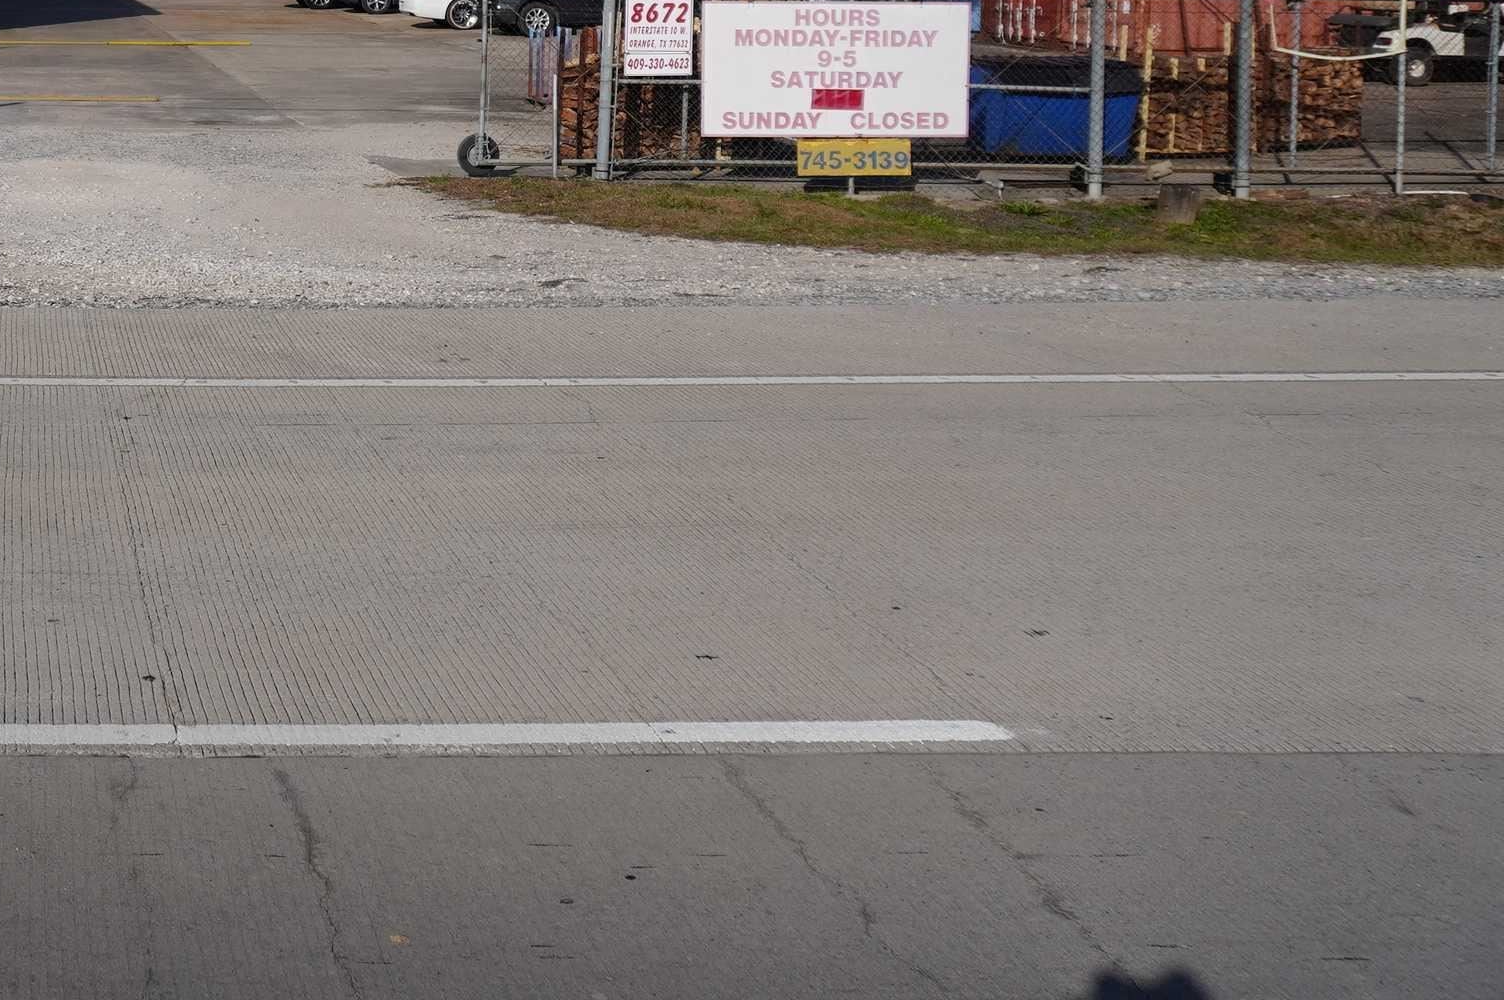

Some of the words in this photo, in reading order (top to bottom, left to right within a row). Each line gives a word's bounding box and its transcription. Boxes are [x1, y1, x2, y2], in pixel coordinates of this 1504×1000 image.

[631, 2, 689, 23] 8672
[794, 8, 880, 26] HOURS
[629, 26, 668, 35] INTERSTATE
[670, 26, 677, 35] 10
[734, 29, 939, 47] MONDAY-FRIDAY
[629, 39, 657, 49] ORANGE,
[659, 39, 666, 49] TX
[627, 57, 689, 70] 409-330-4623
[817, 50, 857, 68] 9-5
[770, 70, 903, 88] SATURDAY
[722, 111, 823, 130] SUNDAY
[850, 111, 949, 130] CLOSED
[800, 150, 909, 170] 745-3139
